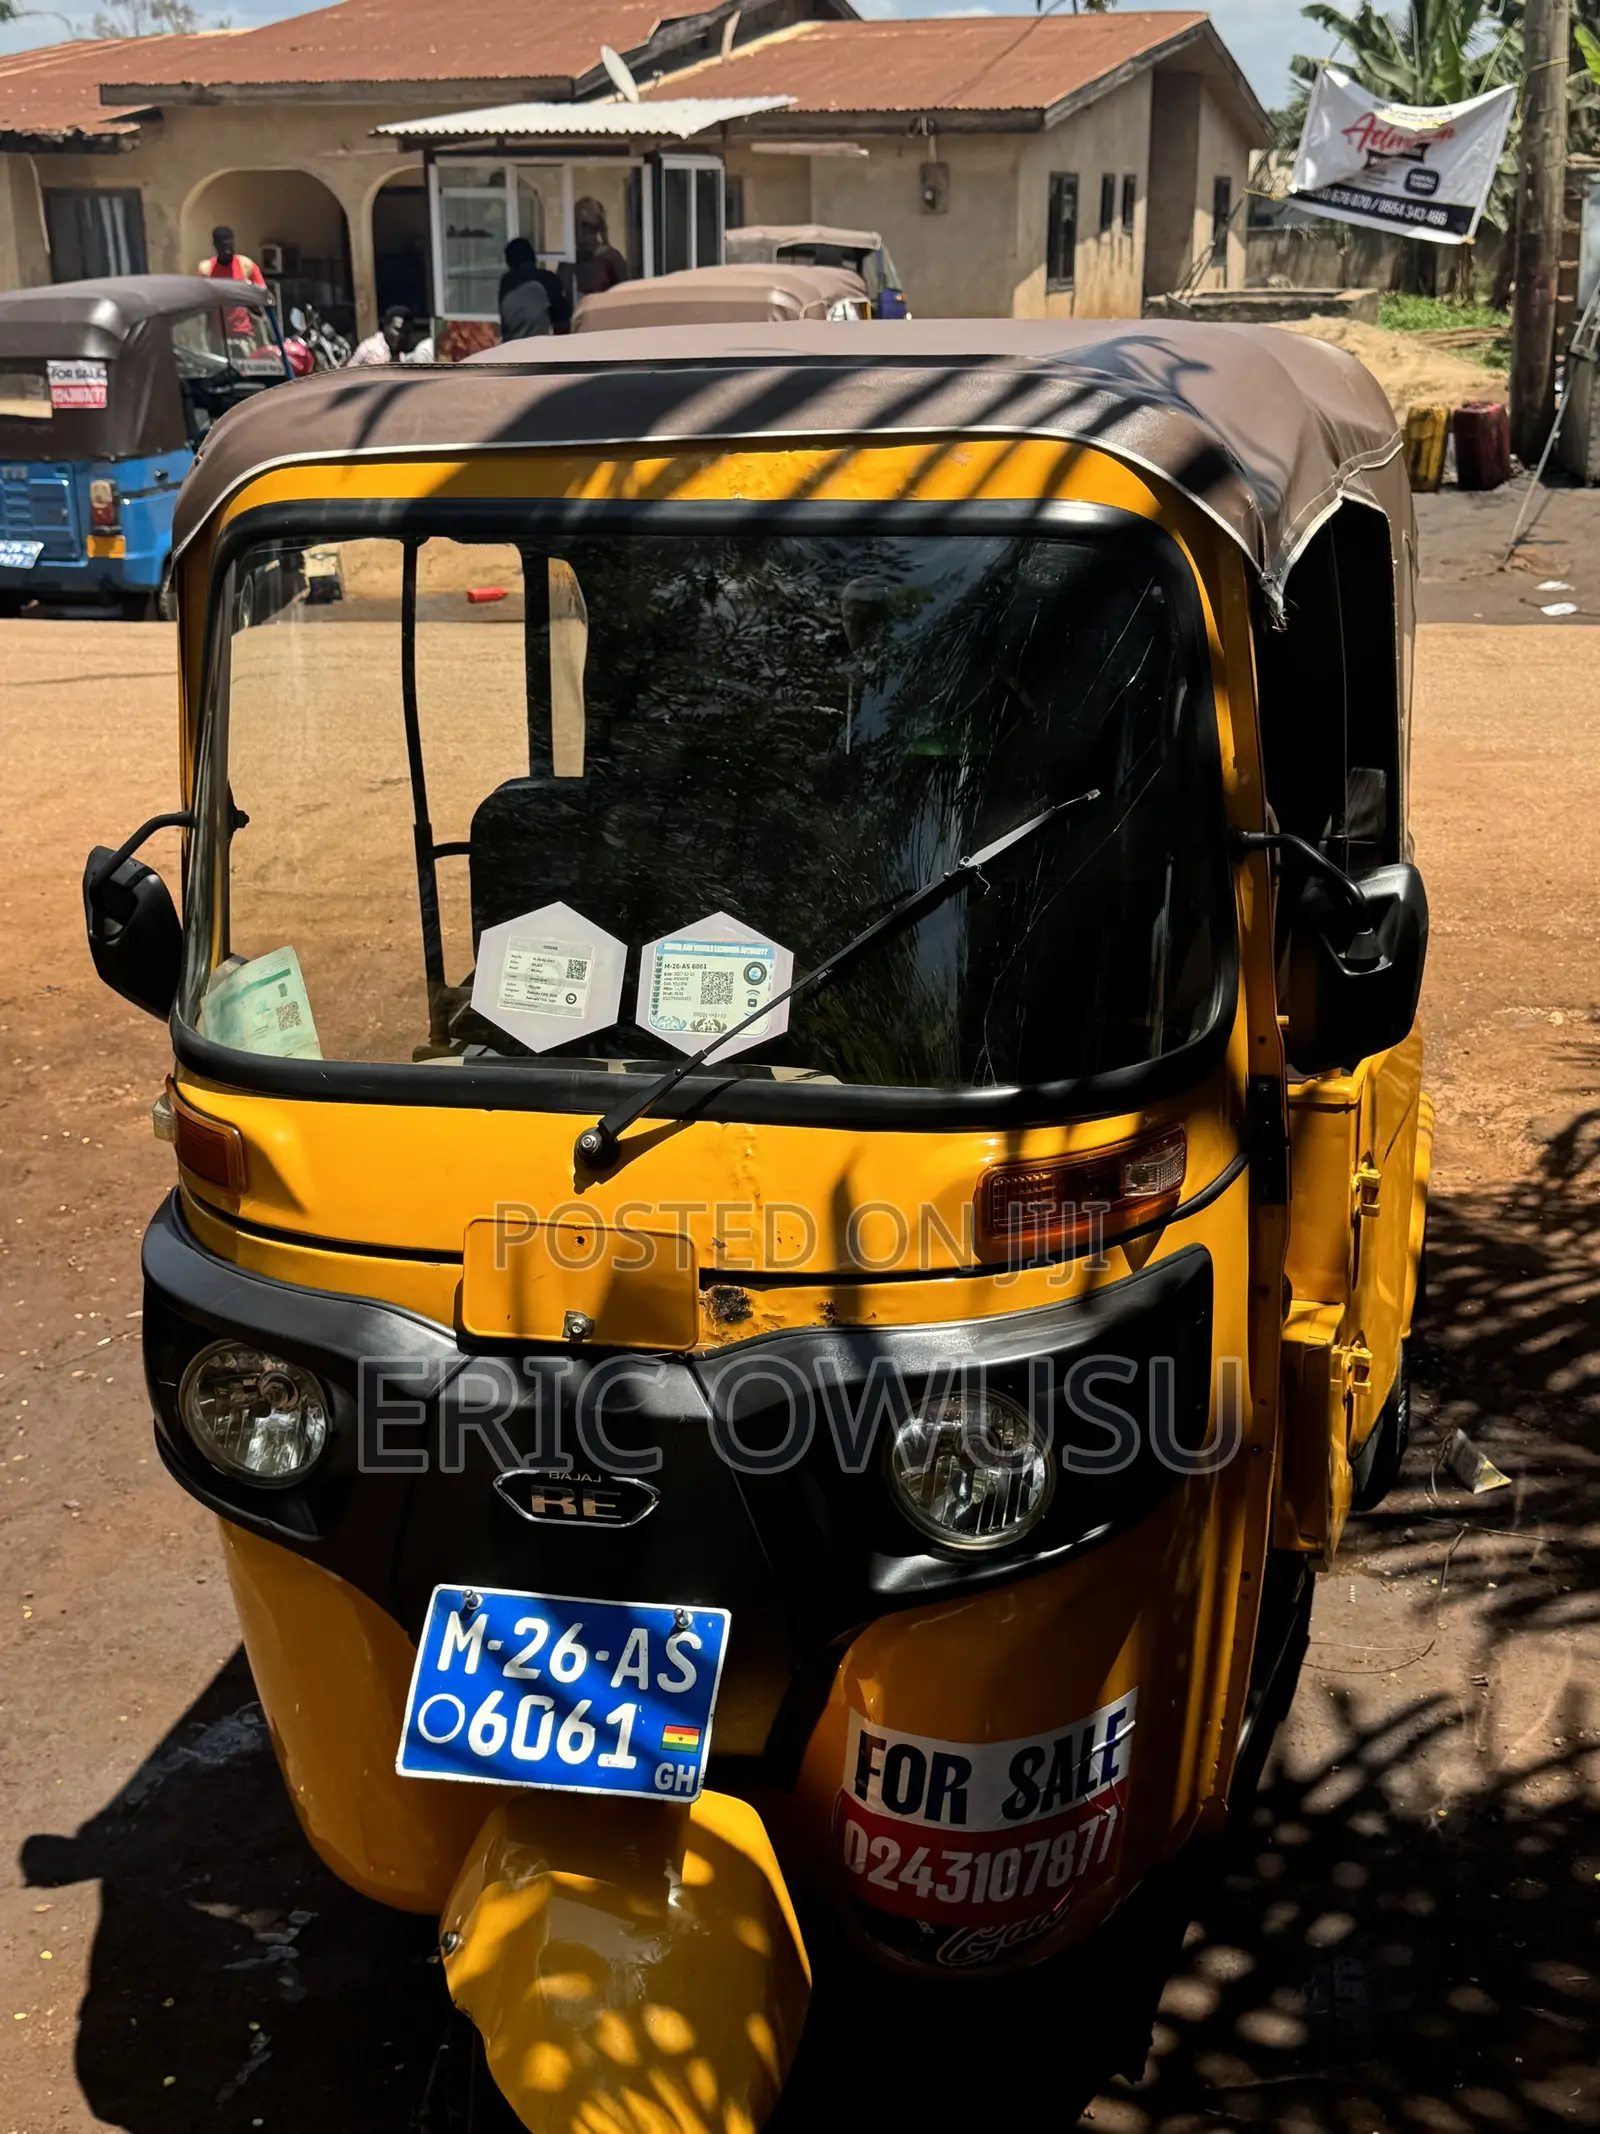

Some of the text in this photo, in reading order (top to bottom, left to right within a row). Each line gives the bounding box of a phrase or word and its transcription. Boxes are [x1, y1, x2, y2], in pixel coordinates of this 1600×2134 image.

[531, 1485, 622, 1519] RE
[549, 1470, 602, 1483] BAJAJ
[436, 1610, 702, 1694] M-26-AS
[654, 1762, 697, 1794] GH
[854, 1706, 1128, 1826] FOR SALE
[843, 1804, 1118, 1905] 0243107877
